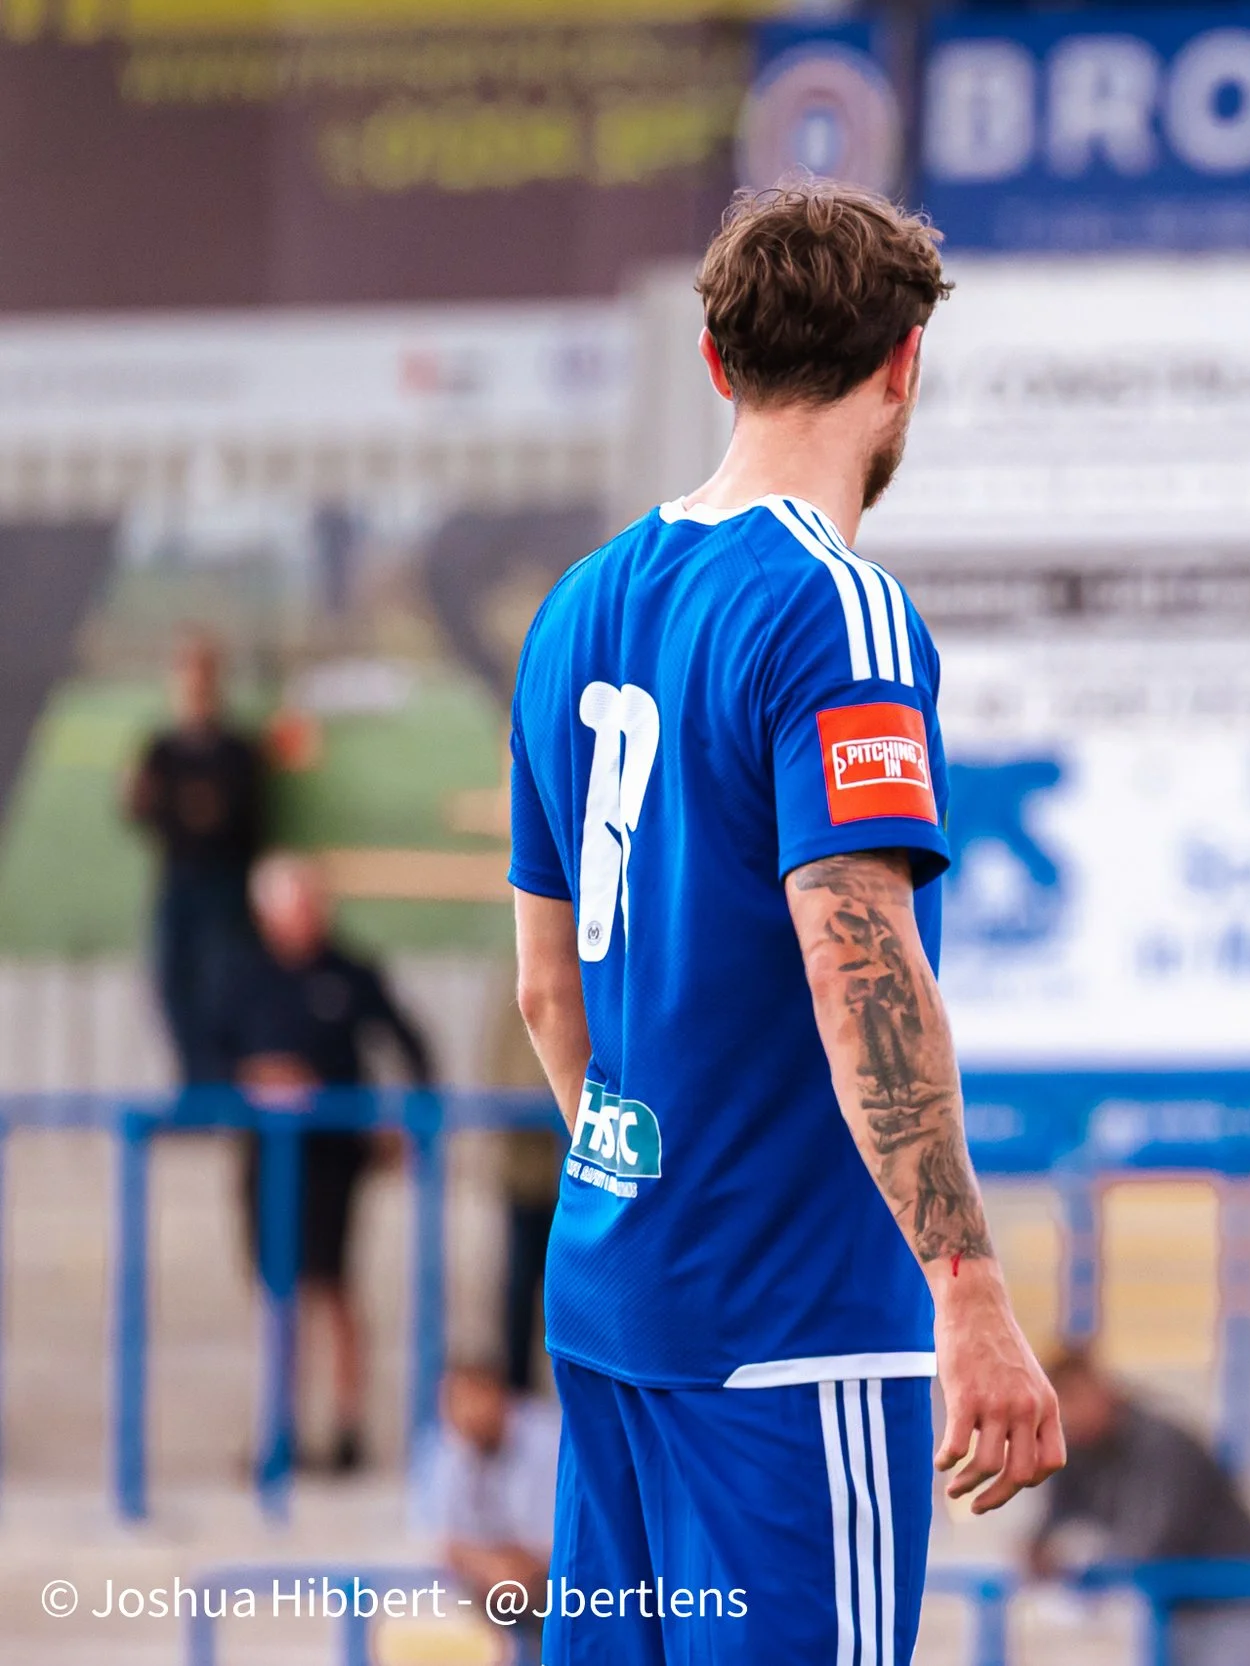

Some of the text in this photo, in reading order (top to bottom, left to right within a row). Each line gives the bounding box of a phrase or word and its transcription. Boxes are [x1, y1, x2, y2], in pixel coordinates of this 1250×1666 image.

[846, 741, 918, 766] PITCHING
[884, 758, 902, 778] IN
[571, 1089, 639, 1167] HSC
